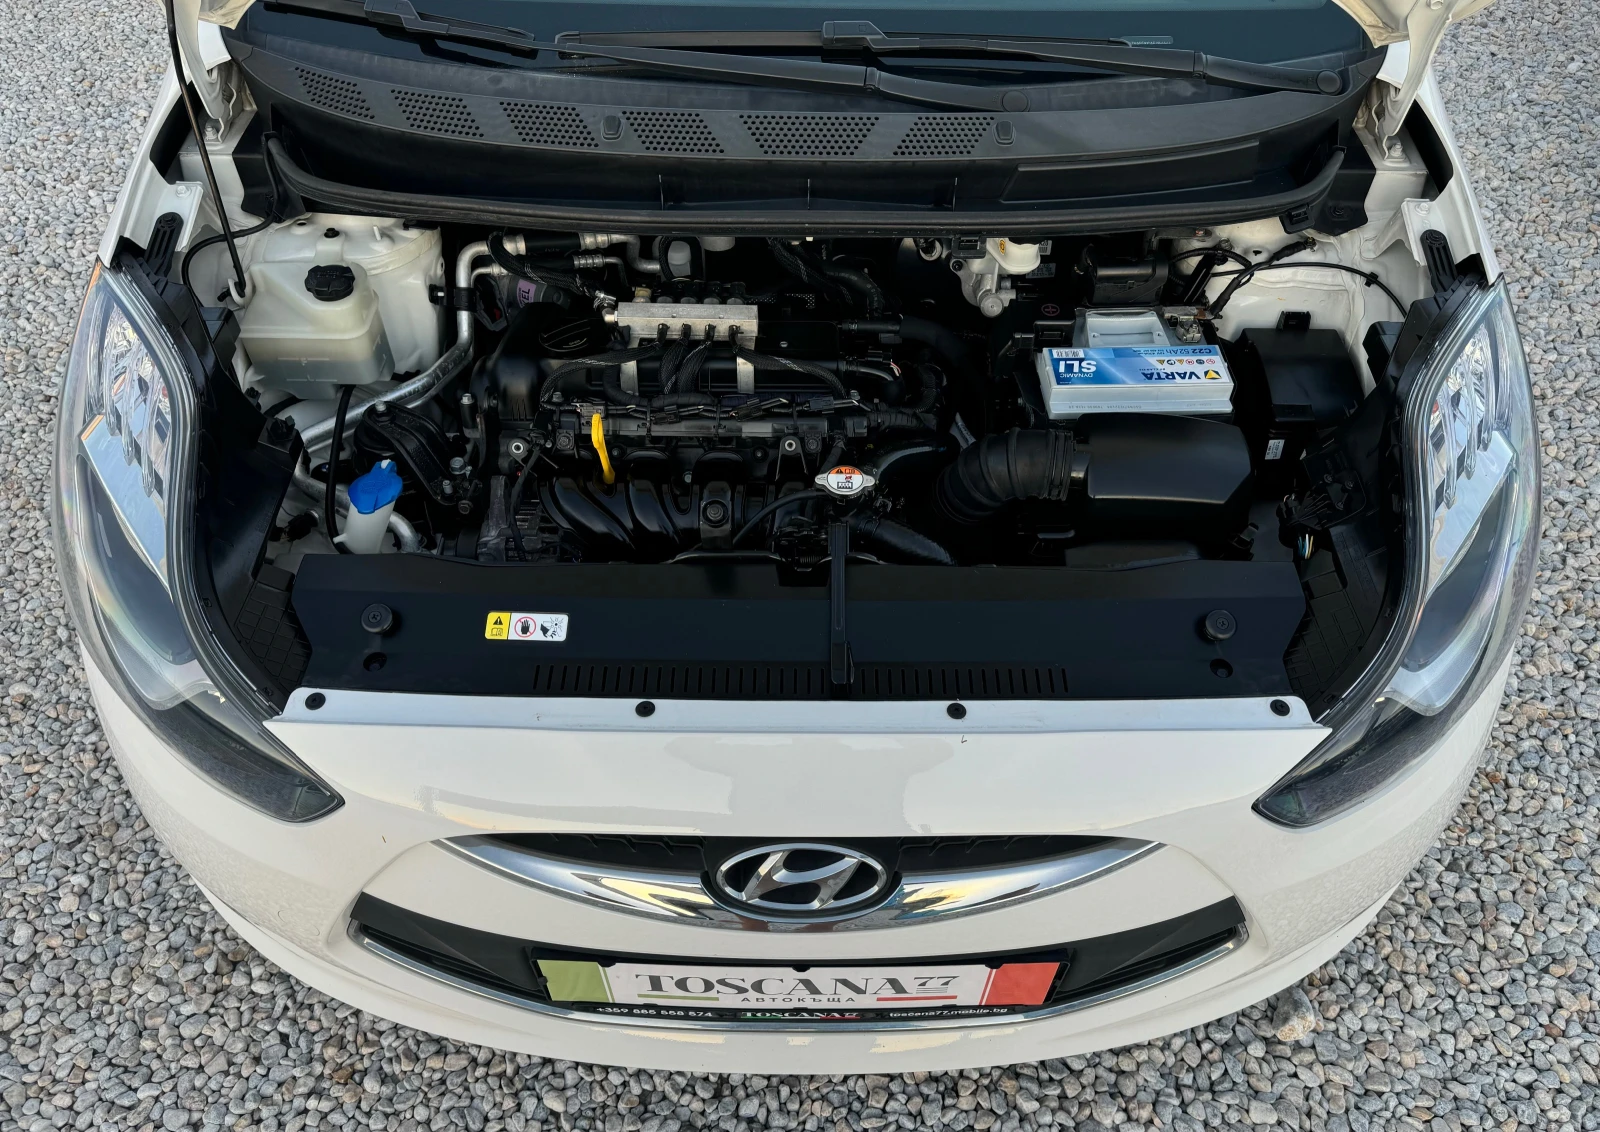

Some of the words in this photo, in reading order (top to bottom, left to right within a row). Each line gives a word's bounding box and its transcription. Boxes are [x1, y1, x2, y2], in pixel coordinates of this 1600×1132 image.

[1058, 360, 1097, 373] SLI
[1141, 372, 1201, 380] VARTA
[889, 1008, 1008, 1018] toscana77.mobile.bg
